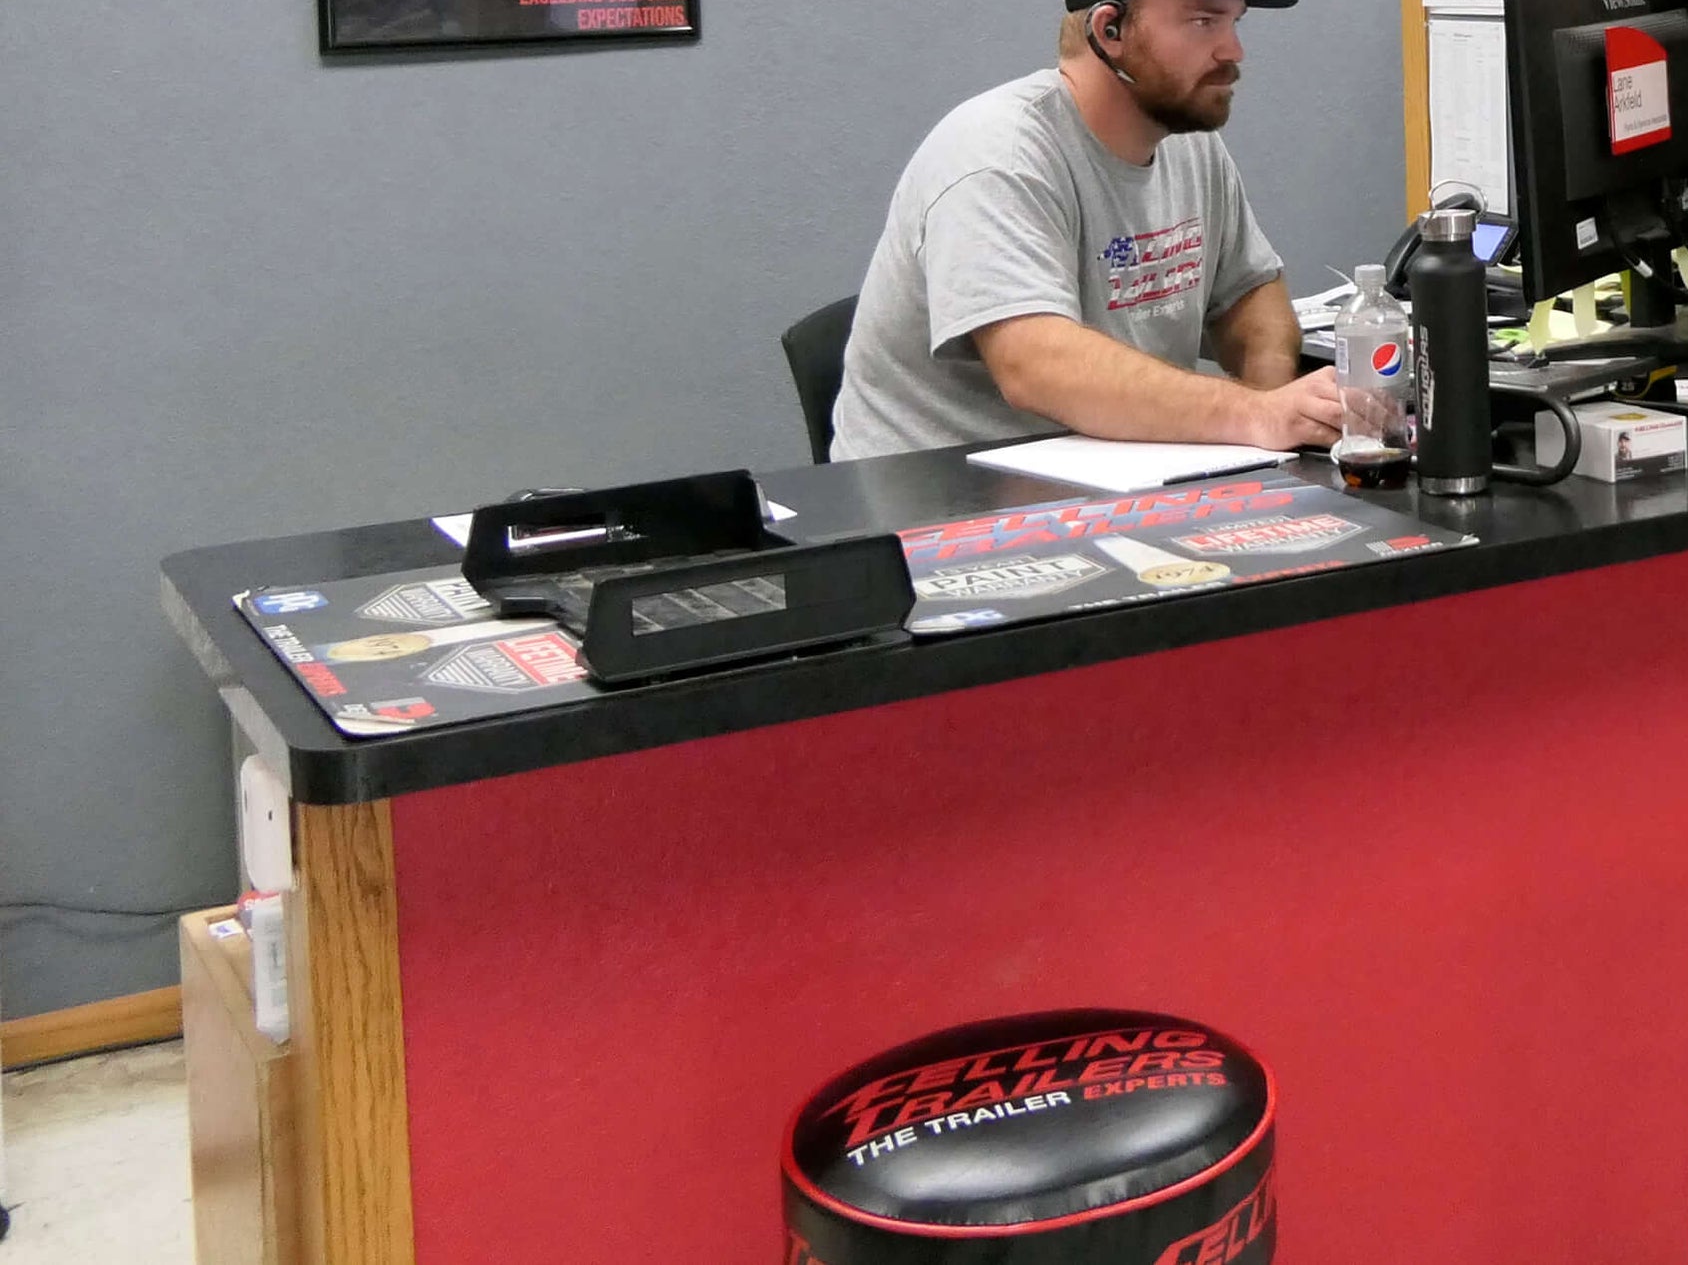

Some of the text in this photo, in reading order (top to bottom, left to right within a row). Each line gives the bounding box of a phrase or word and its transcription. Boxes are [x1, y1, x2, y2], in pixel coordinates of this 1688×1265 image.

[1614, 75, 1633, 93] Lane
[1184, 517, 1345, 547] LIFETIME
[928, 560, 1070, 590] PAINT
[817, 1029, 1208, 1122] FELLING
[843, 1049, 1227, 1150] TRAILERS
[845, 1070, 1228, 1167] THE TRAILER EXPERTS
